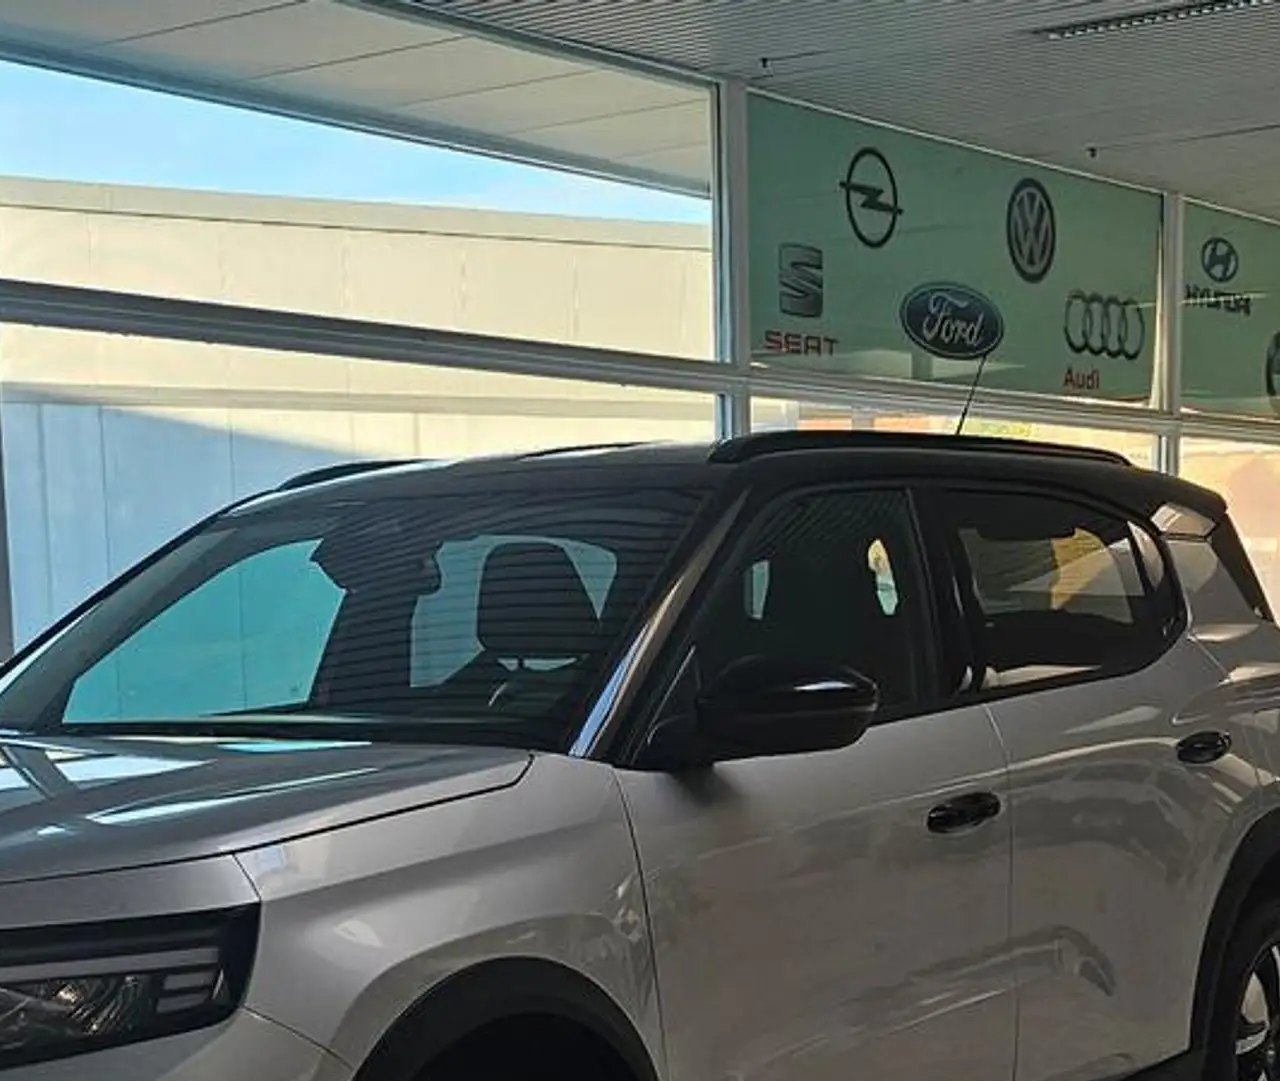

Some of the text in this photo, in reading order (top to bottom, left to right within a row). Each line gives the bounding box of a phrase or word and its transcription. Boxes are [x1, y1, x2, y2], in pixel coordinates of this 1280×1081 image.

[923, 290, 986, 347] Ford
[764, 330, 839, 356] SEAT
[1064, 366, 1100, 390] Audi
